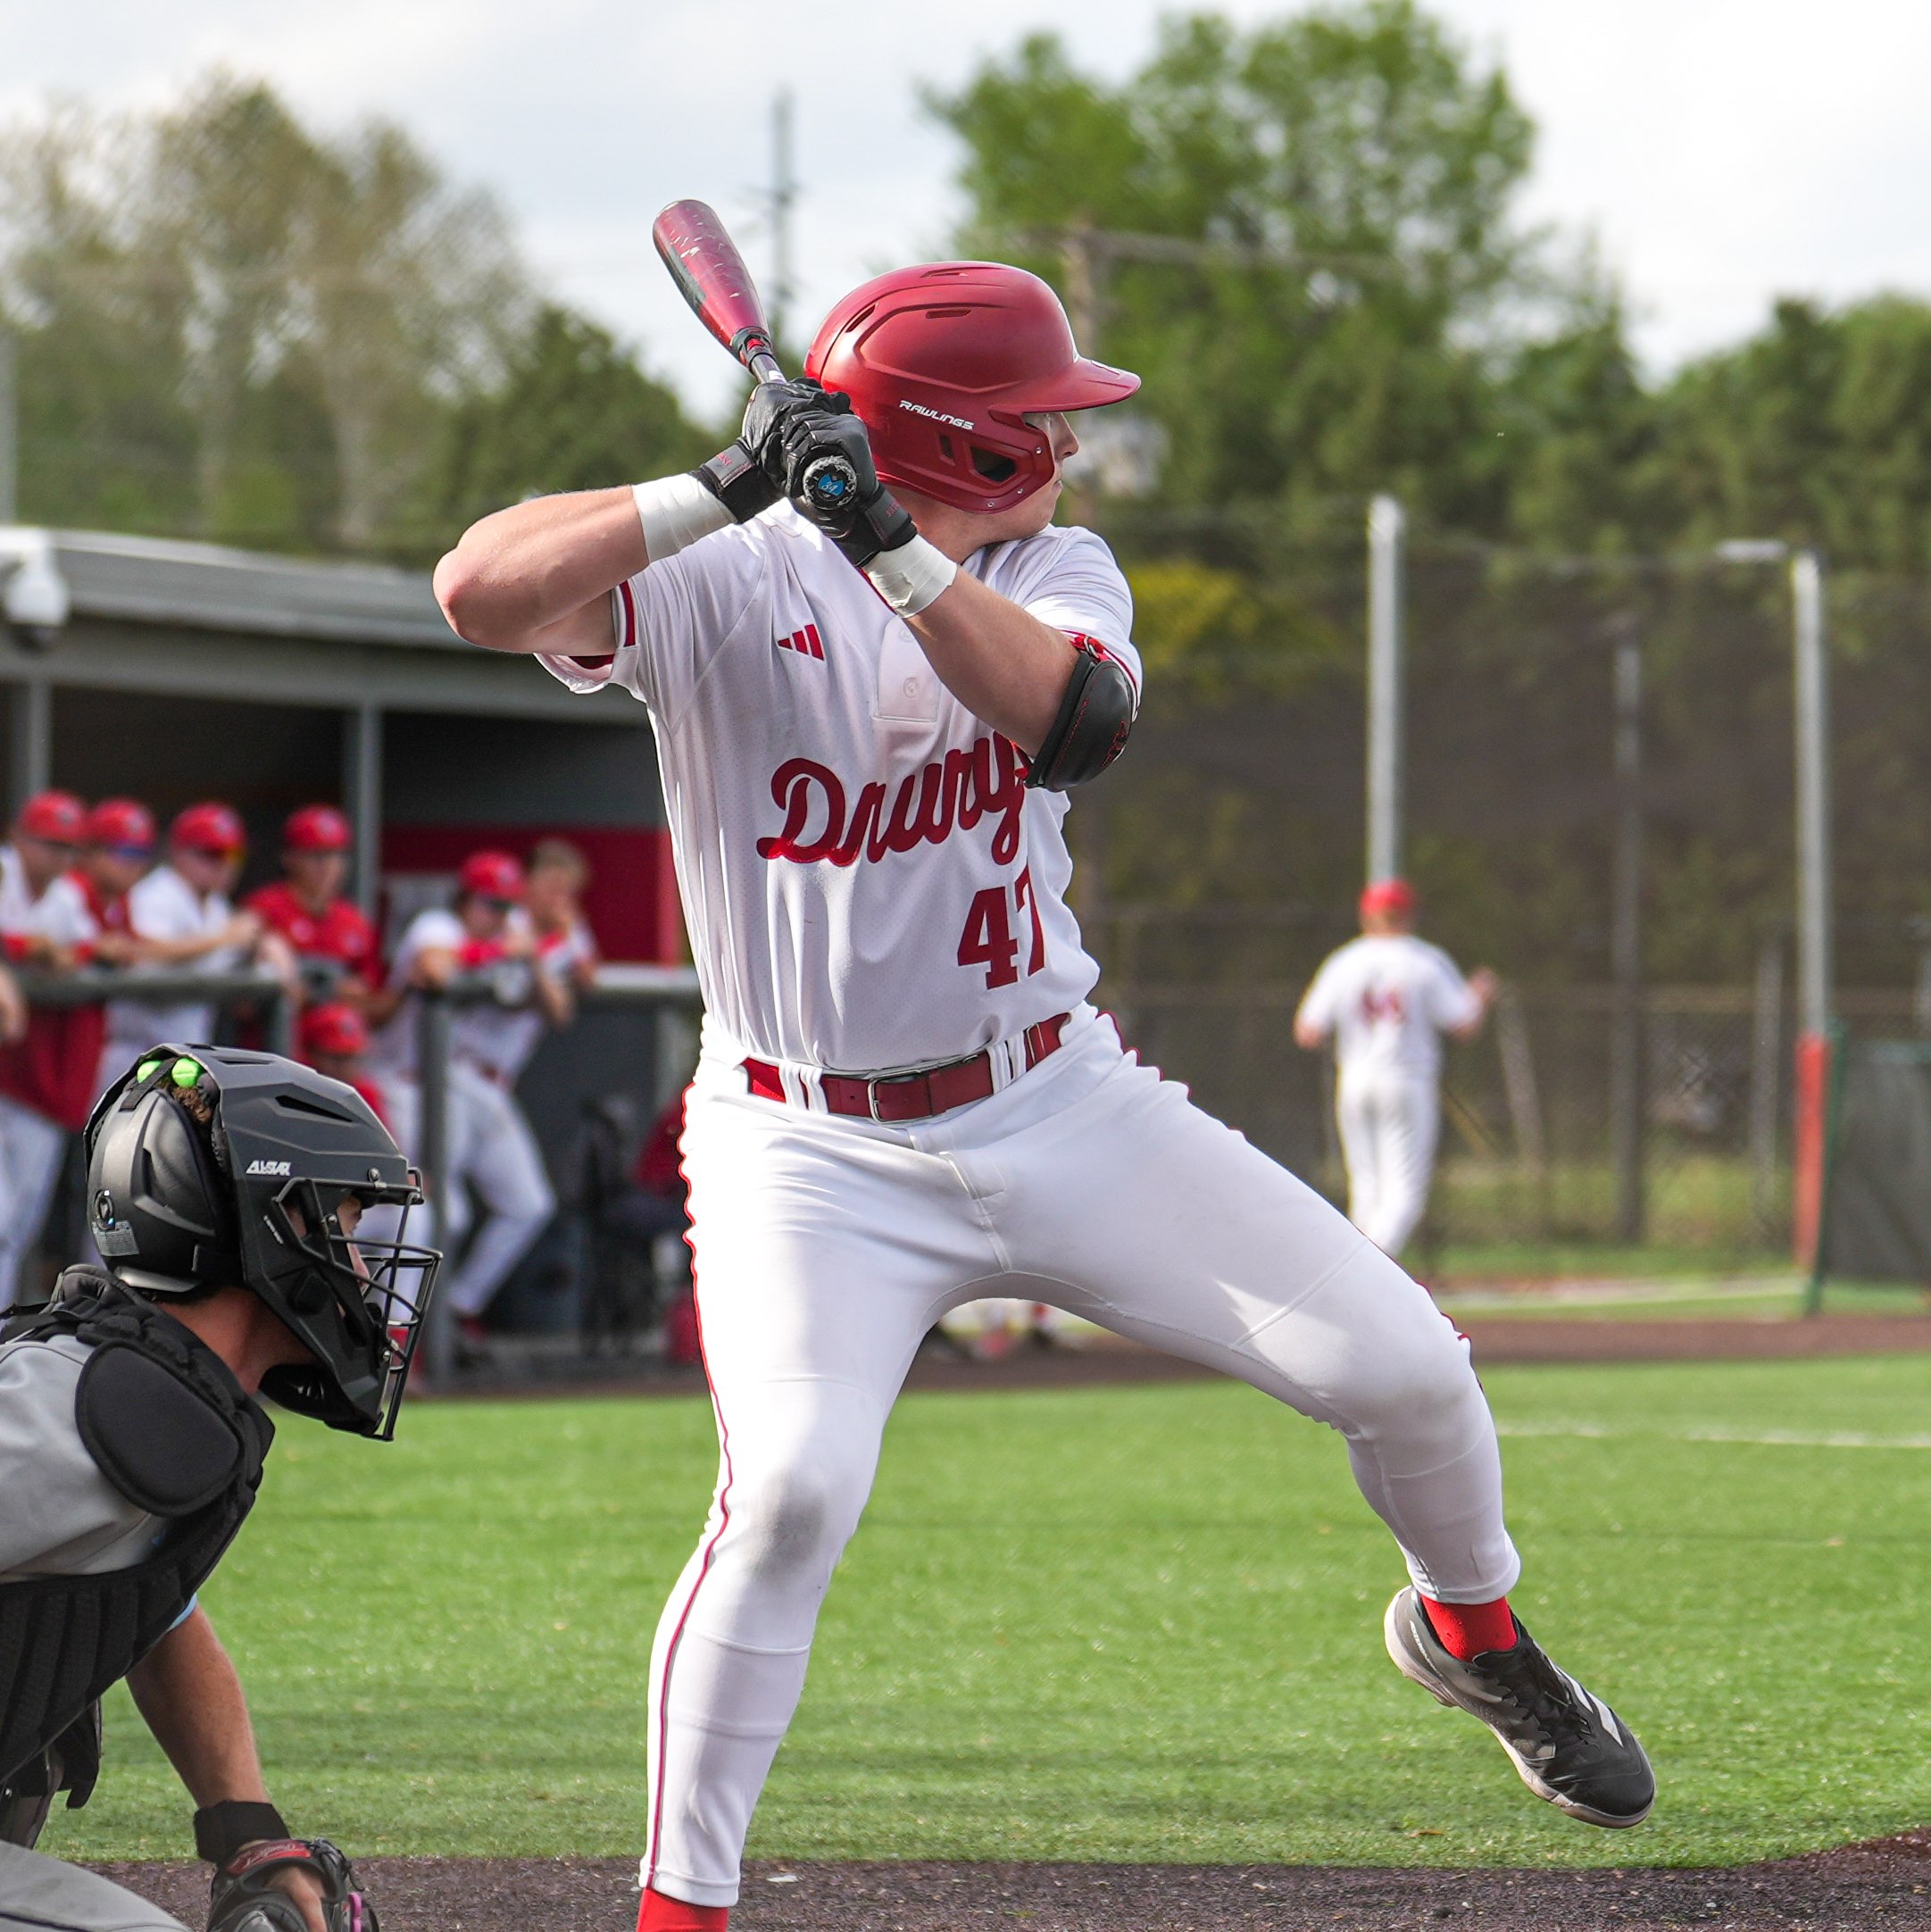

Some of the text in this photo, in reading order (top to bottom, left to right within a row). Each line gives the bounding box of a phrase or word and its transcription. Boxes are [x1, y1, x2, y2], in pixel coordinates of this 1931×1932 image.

[899, 399, 975, 430] RAWLINGS
[756, 729, 1034, 867] Drury
[957, 861, 1045, 990] 47
